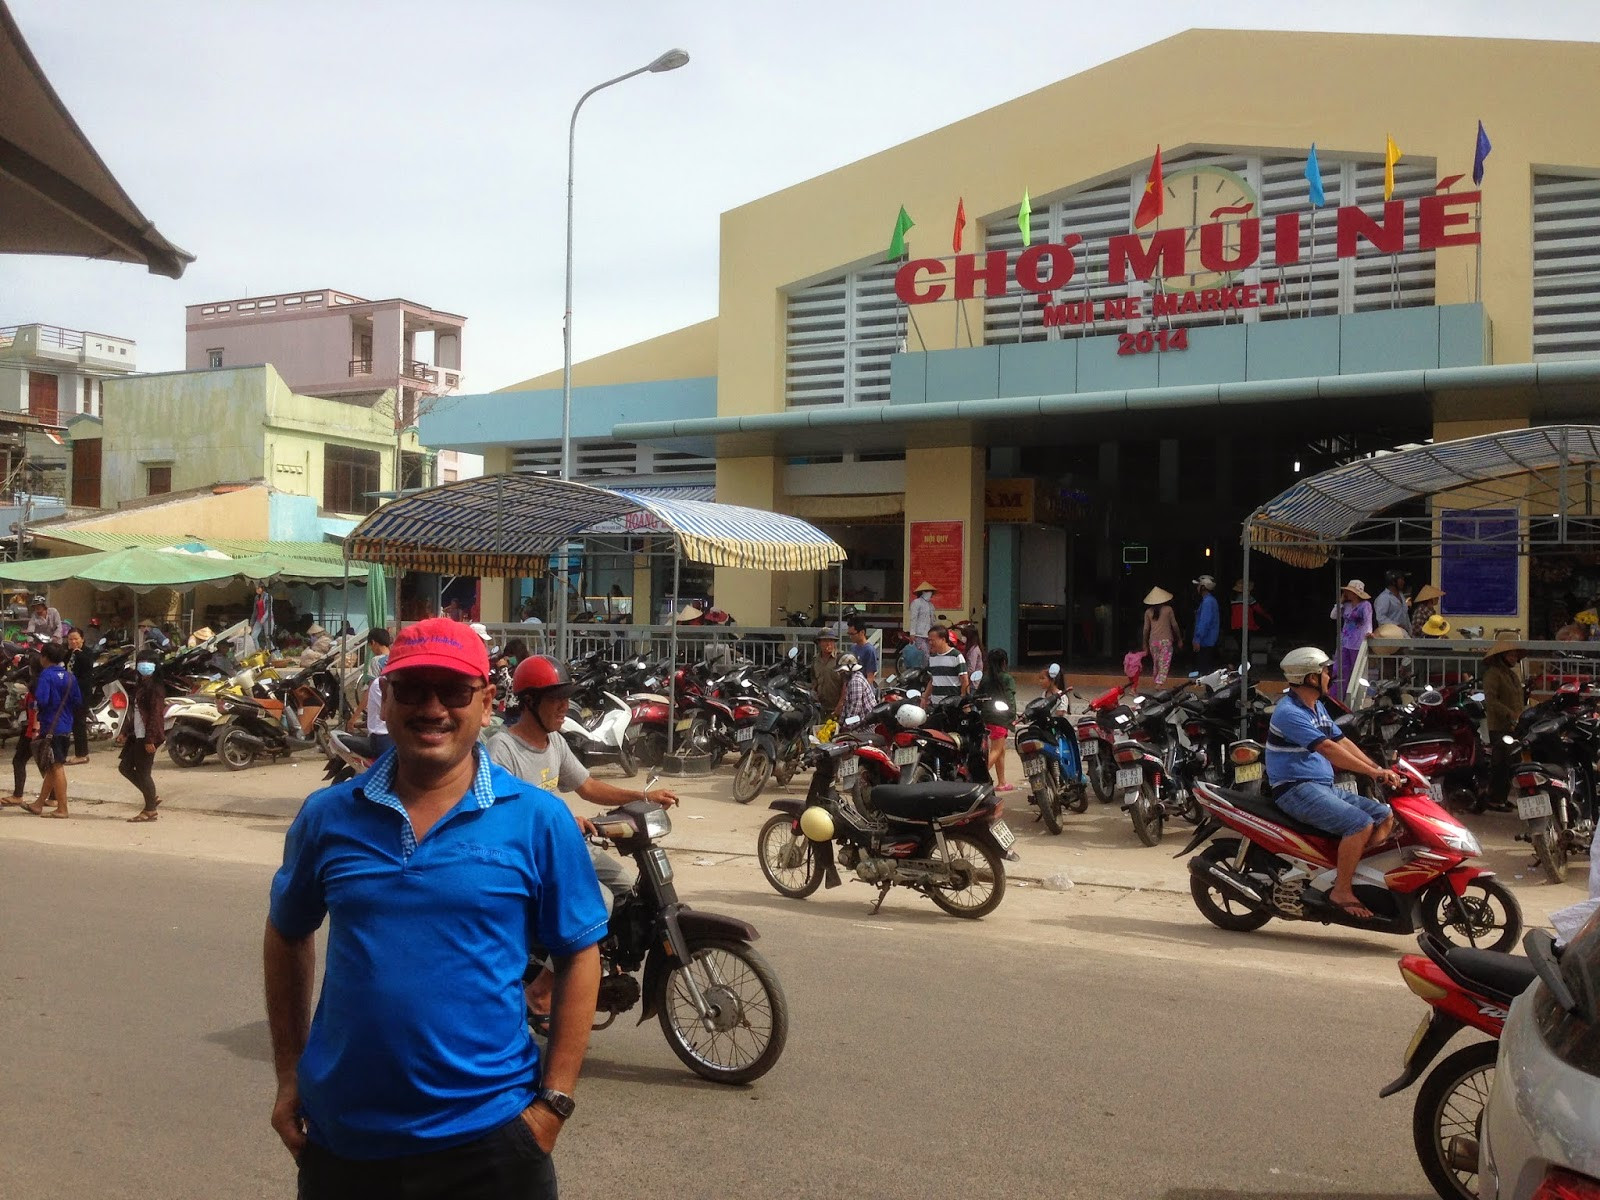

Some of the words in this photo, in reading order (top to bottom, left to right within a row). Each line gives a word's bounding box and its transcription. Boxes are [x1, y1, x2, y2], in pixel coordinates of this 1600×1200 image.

[894, 233, 1083, 305] CHỢ
[1108, 203, 1299, 284] MŨI
[1337, 173, 1482, 259] NÉ
[1042, 302, 1094, 328] MUI
[1104, 297, 1142, 321] NE
[1153, 282, 1280, 317] MARKET
[1117, 328, 1189, 356] 2014
